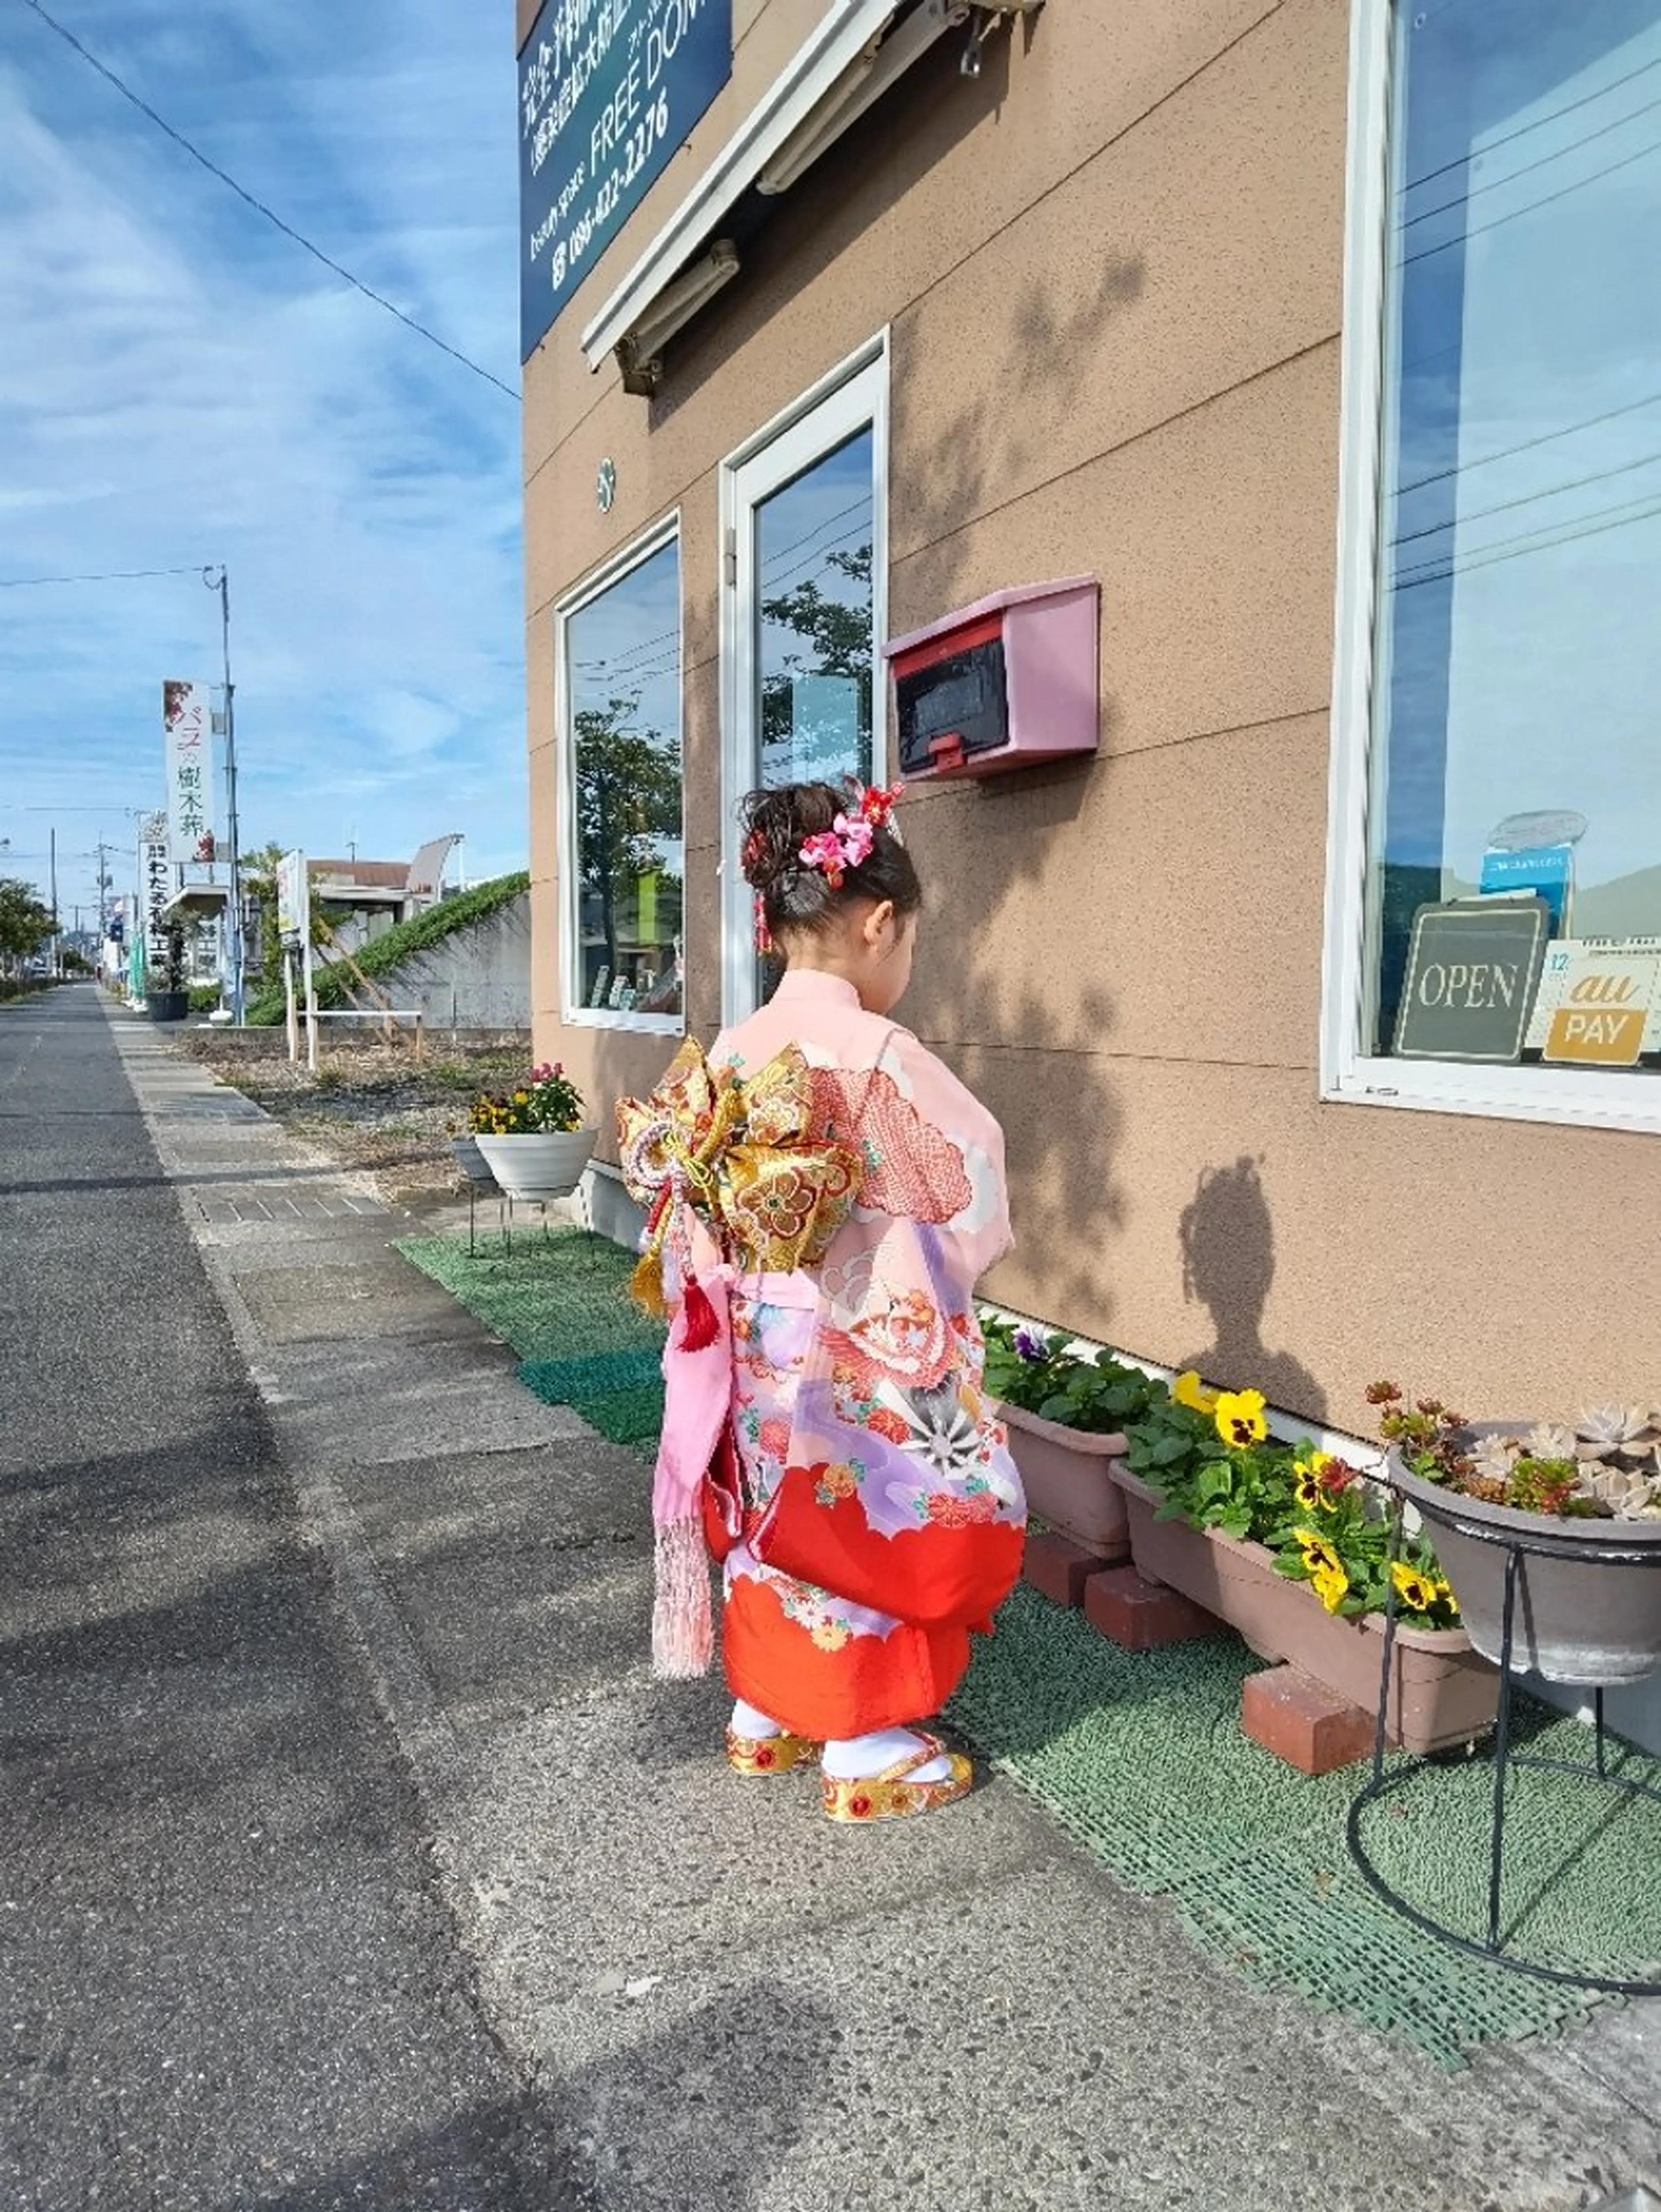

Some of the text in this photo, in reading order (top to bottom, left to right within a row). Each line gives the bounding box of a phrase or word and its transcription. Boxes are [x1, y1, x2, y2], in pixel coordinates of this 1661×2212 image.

[591, 57, 640, 177] FREE
[1419, 963, 1519, 1008] OPEN
[1569, 974, 1640, 1003] au
[1564, 1014, 1629, 1044] PAY
